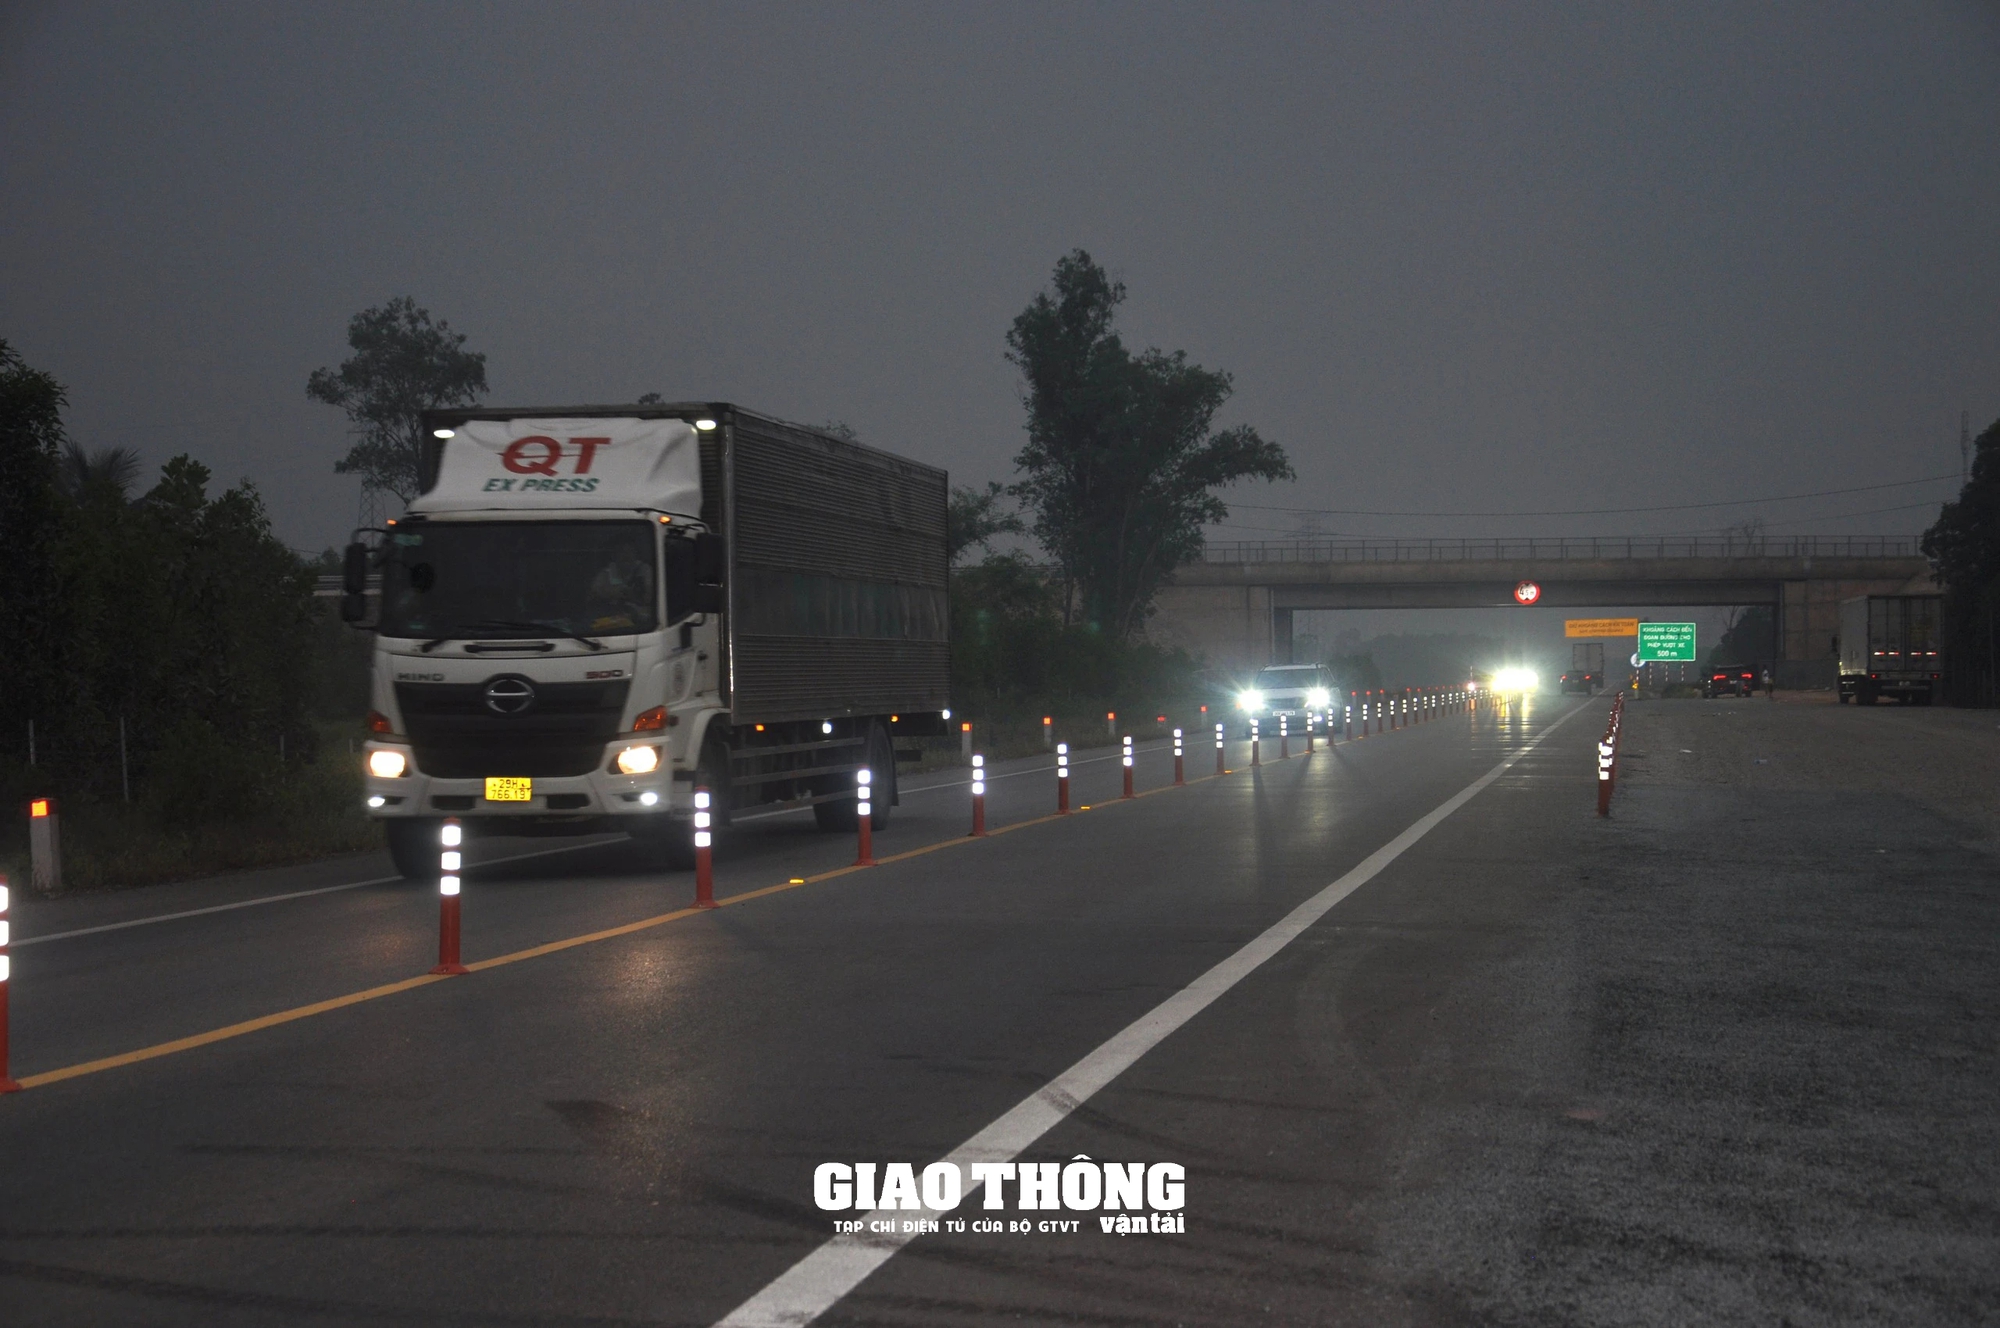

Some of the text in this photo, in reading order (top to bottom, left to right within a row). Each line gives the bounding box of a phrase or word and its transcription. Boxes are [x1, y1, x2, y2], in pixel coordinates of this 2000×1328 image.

[502, 435, 611, 477] QT
[398, 672, 444, 682] HINO
[585, 669, 624, 680] 500
